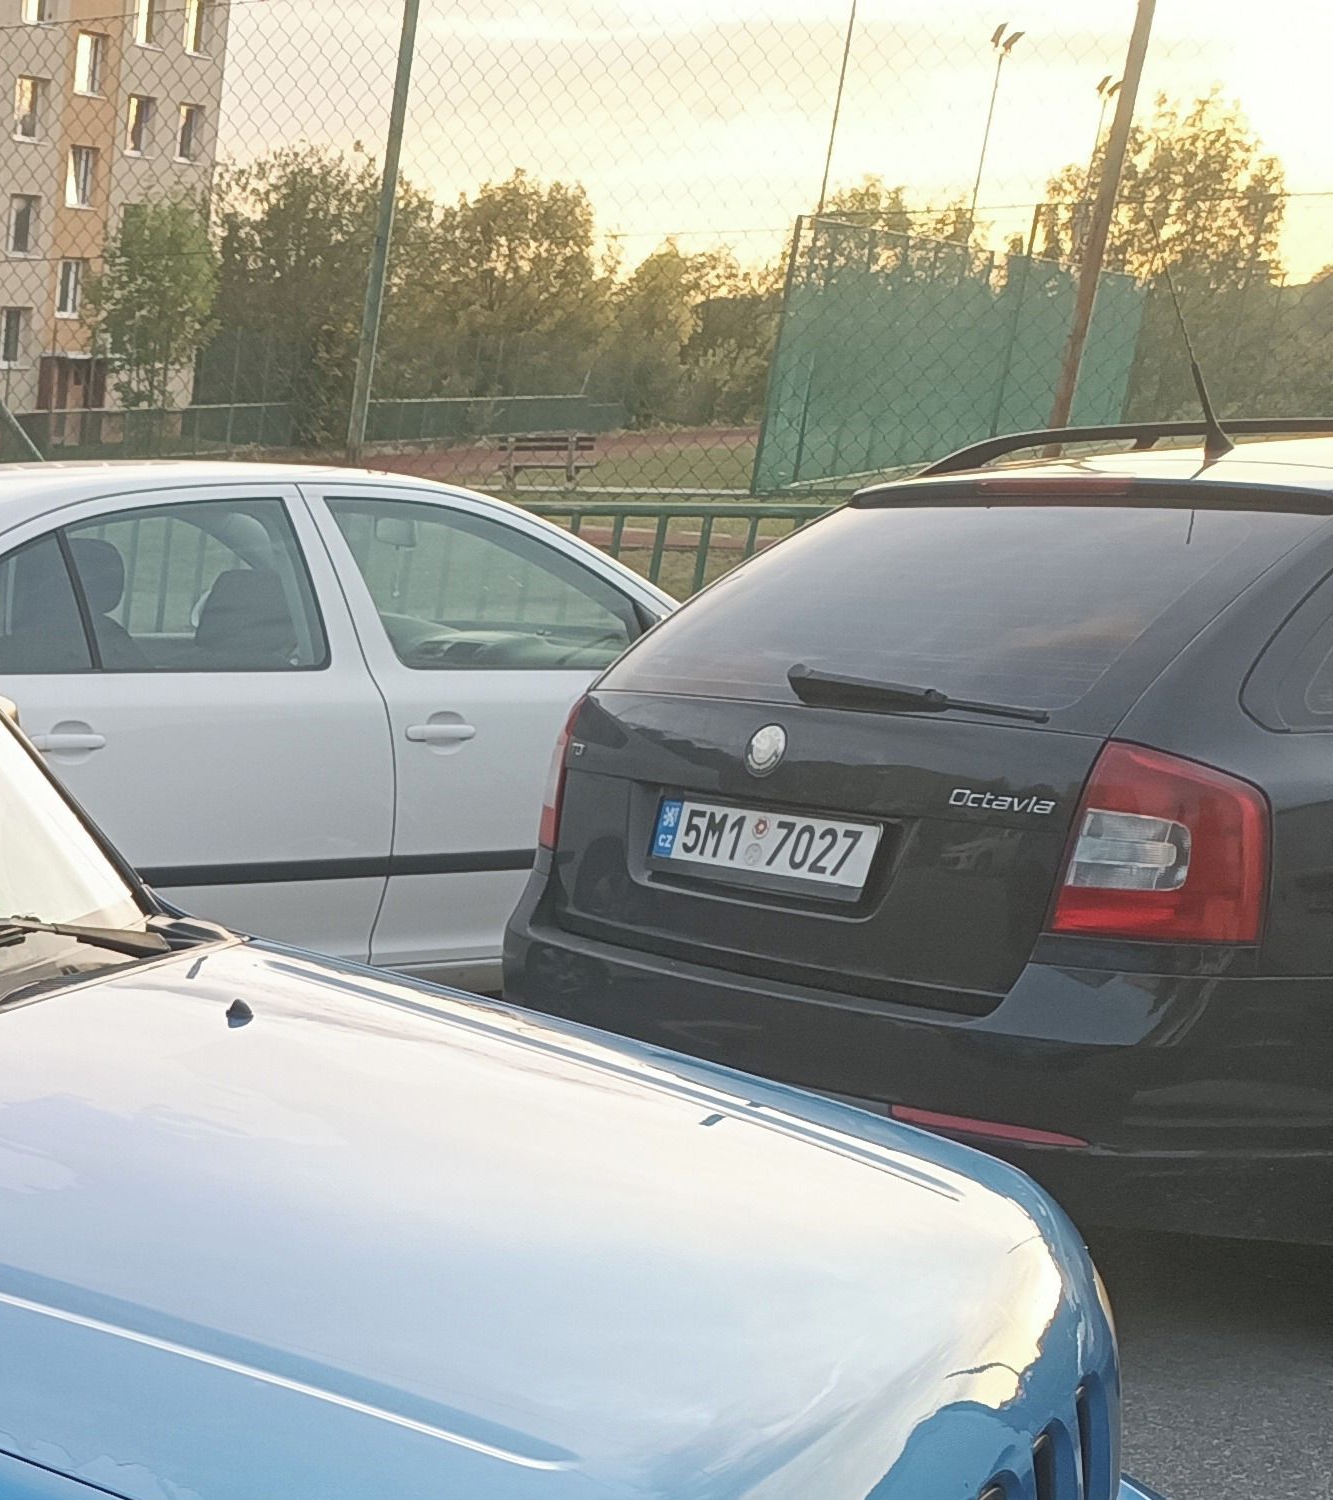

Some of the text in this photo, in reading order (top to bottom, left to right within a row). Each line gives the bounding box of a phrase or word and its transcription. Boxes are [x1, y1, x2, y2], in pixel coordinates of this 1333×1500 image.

[949, 788, 1056, 815] Octavia
[658, 835, 672, 849] CZ
[682, 809, 863, 877] 5M1 7027
